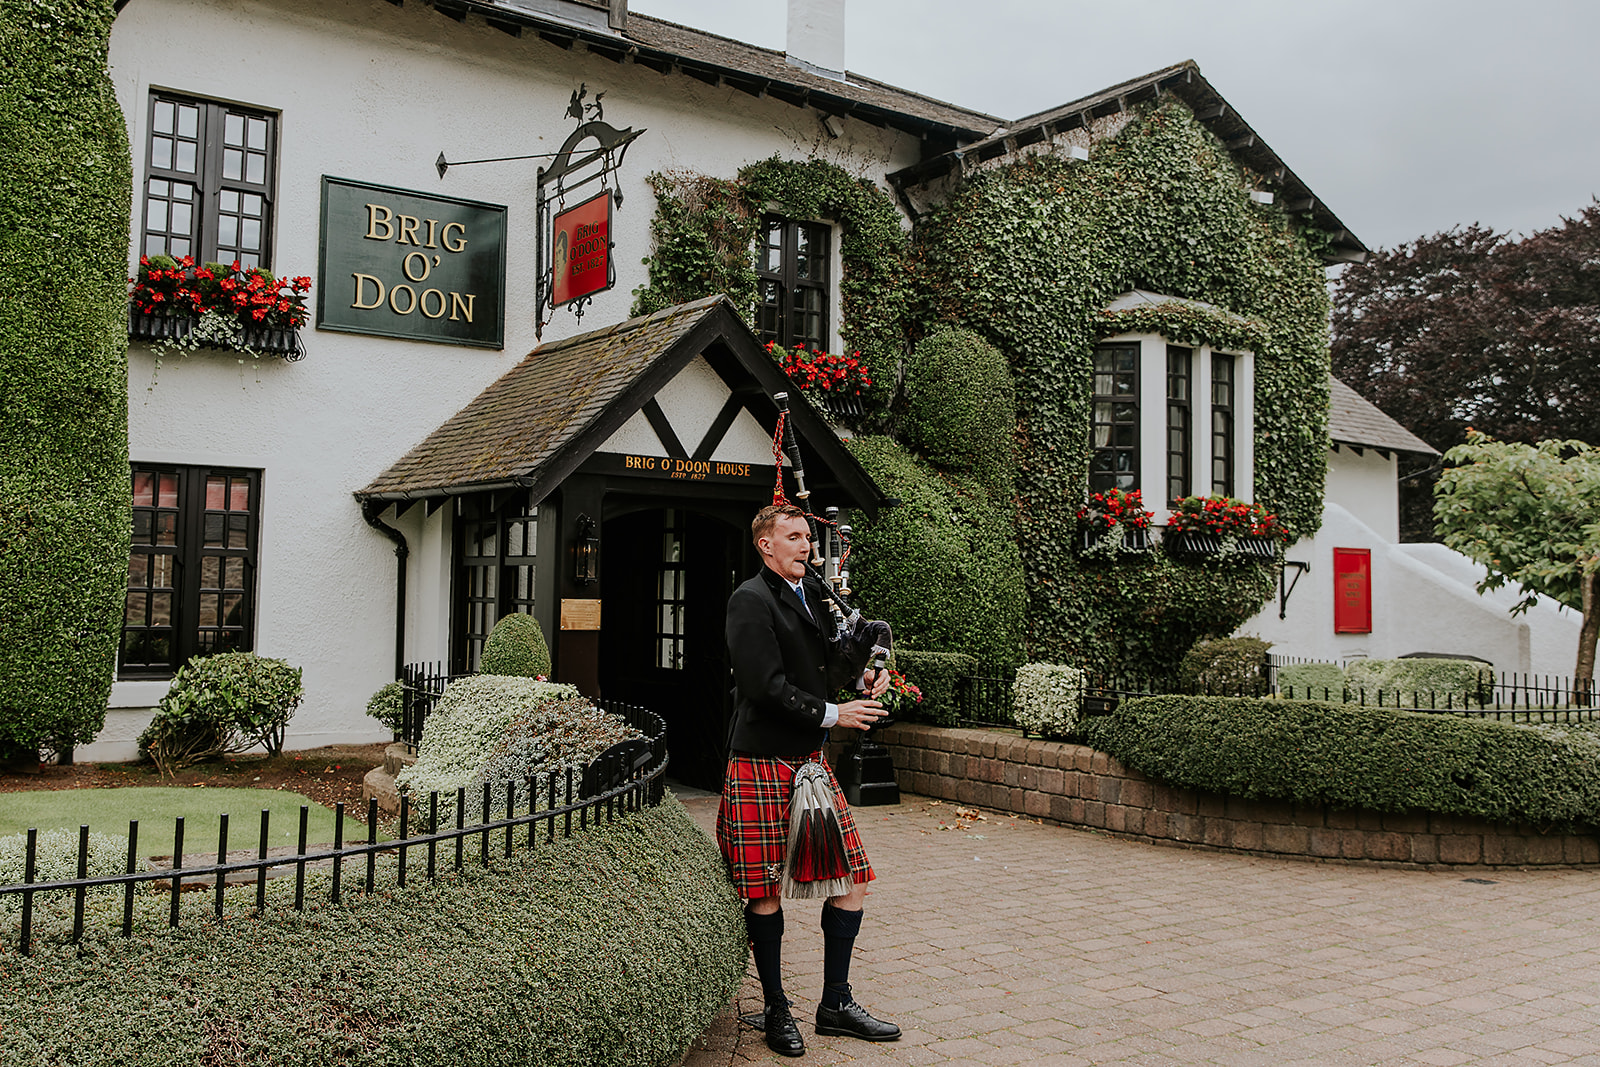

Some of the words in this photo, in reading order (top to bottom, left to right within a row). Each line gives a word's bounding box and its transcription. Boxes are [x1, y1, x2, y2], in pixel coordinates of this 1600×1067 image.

[364, 203, 468, 252] BRIG
[576, 221, 599, 242] BRIG
[569, 235, 607, 261] O'DOON
[404, 251, 441, 282] O'
[572, 262, 586, 276] EST.
[587, 255, 604, 271] 1827
[351, 272, 476, 323] DOON
[625, 455, 655, 470] BRIG
[716, 462, 751, 477] HOUSE
